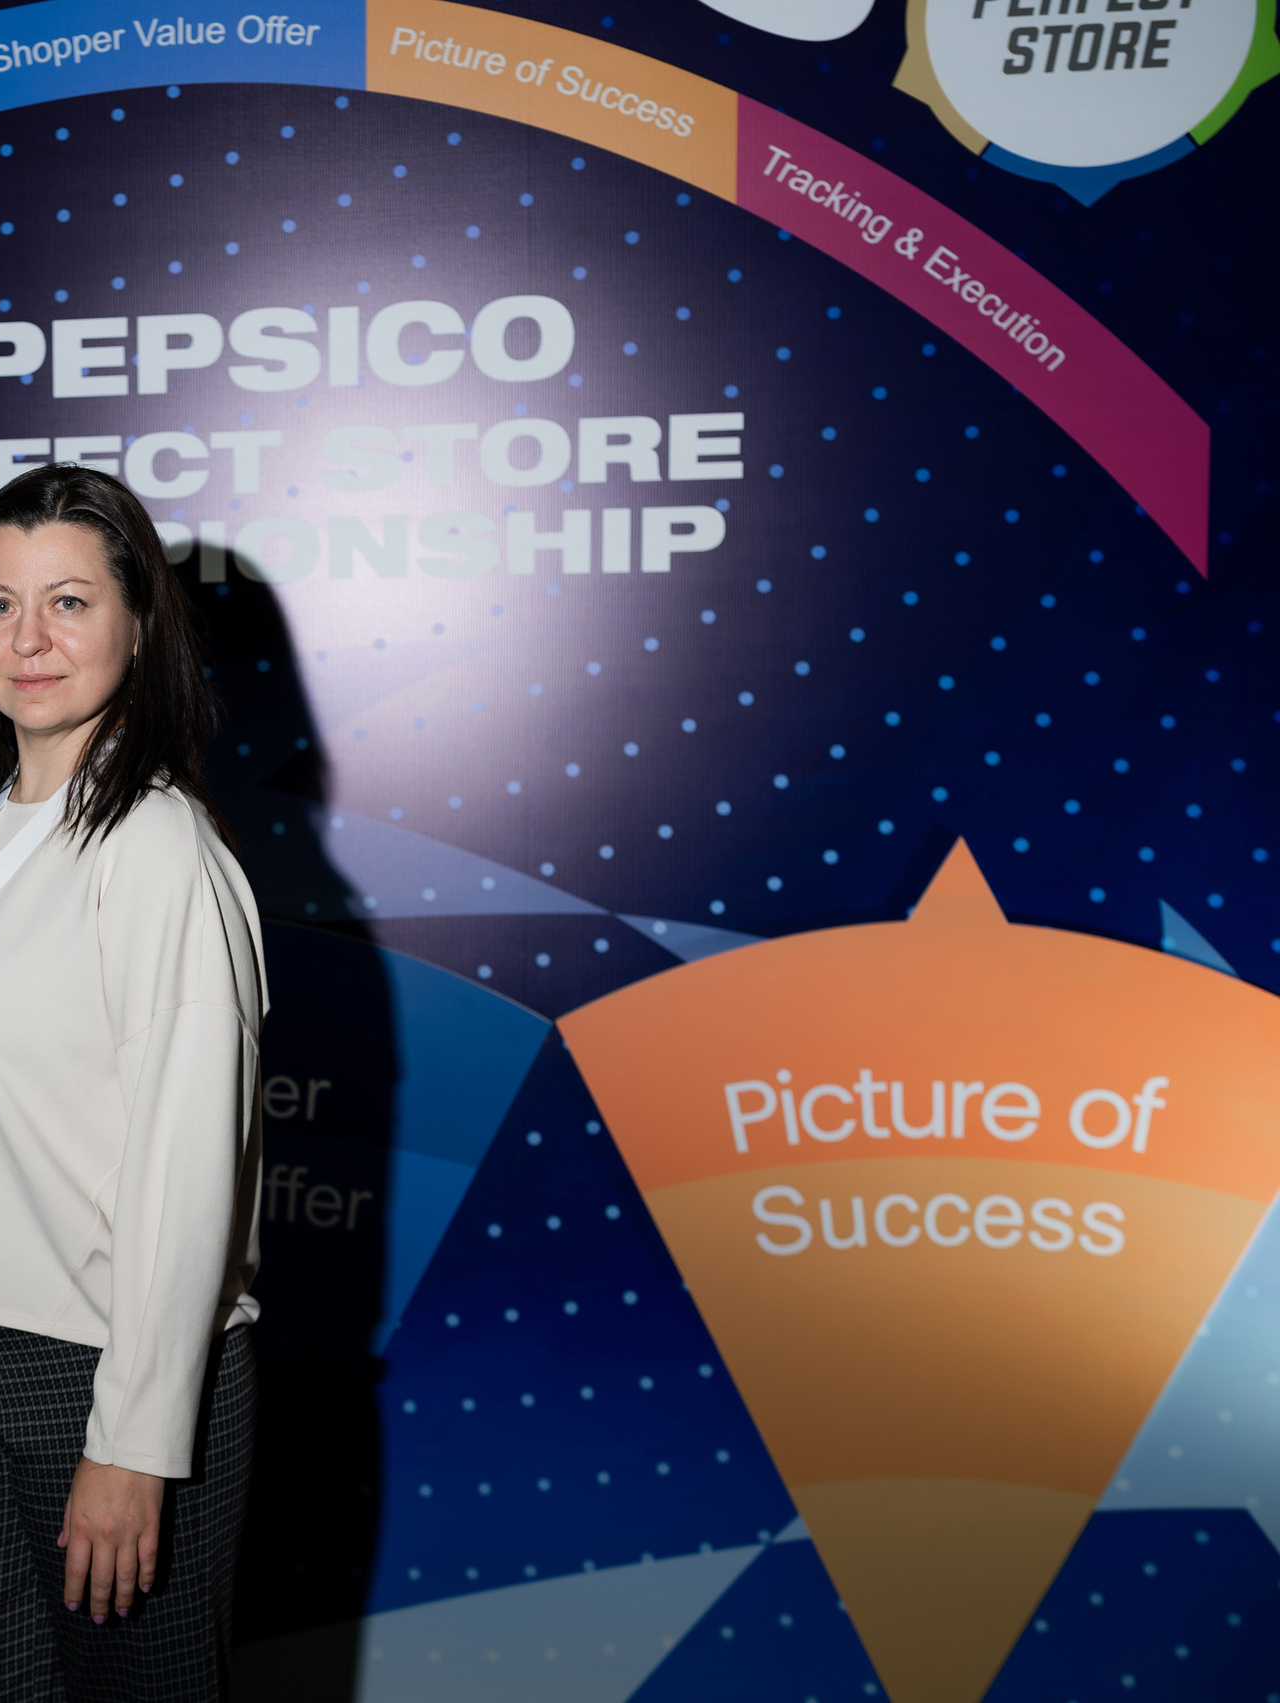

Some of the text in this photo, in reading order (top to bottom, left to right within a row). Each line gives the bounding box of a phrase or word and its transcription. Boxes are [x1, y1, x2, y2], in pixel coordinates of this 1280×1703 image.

[133, 16, 227, 49] Value
[236, 14, 320, 46] Offer
[1003, 20, 1178, 75] STORE
[390, 26, 696, 138] Picture of Success
[763, 144, 1067, 373] Tracking & Execution
[320, 412, 745, 493] STORE
[724, 1068, 1170, 1154] Picture of
[263, 1162, 375, 1232] ffer
[751, 1184, 1127, 1257] Success
